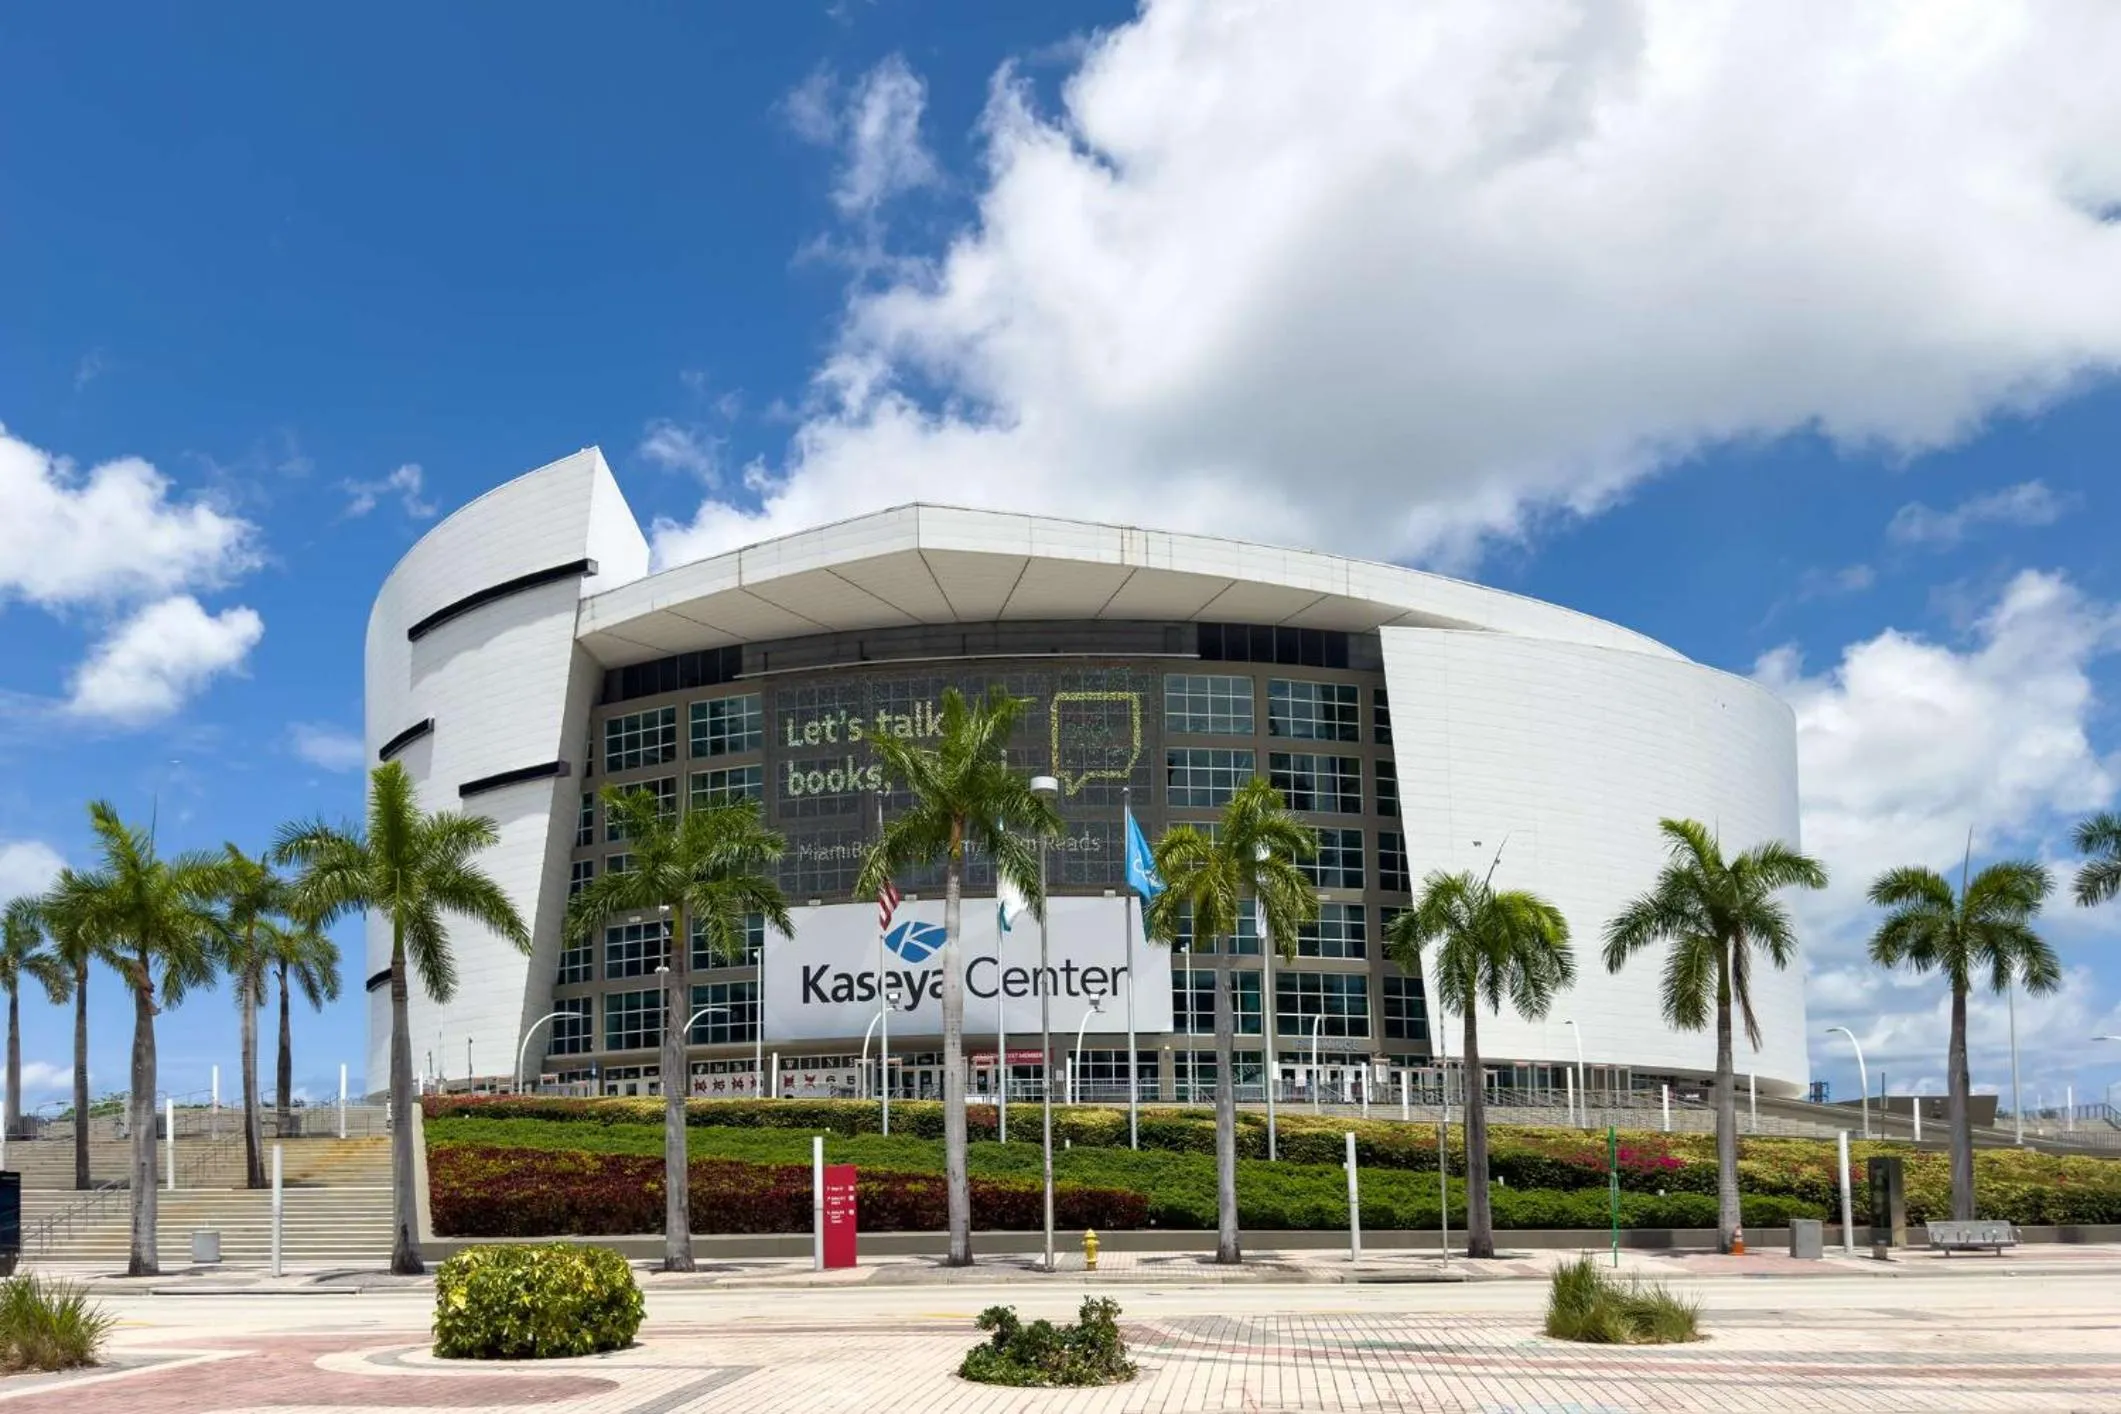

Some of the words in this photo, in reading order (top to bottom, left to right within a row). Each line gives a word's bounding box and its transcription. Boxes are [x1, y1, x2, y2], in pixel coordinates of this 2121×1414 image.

[787, 709, 863, 748] Let's
[875, 701, 945, 738] talk
[787, 755, 893, 797] books,
[802, 964, 945, 1011] Kaseya
[965, 957, 1128, 999] Center
